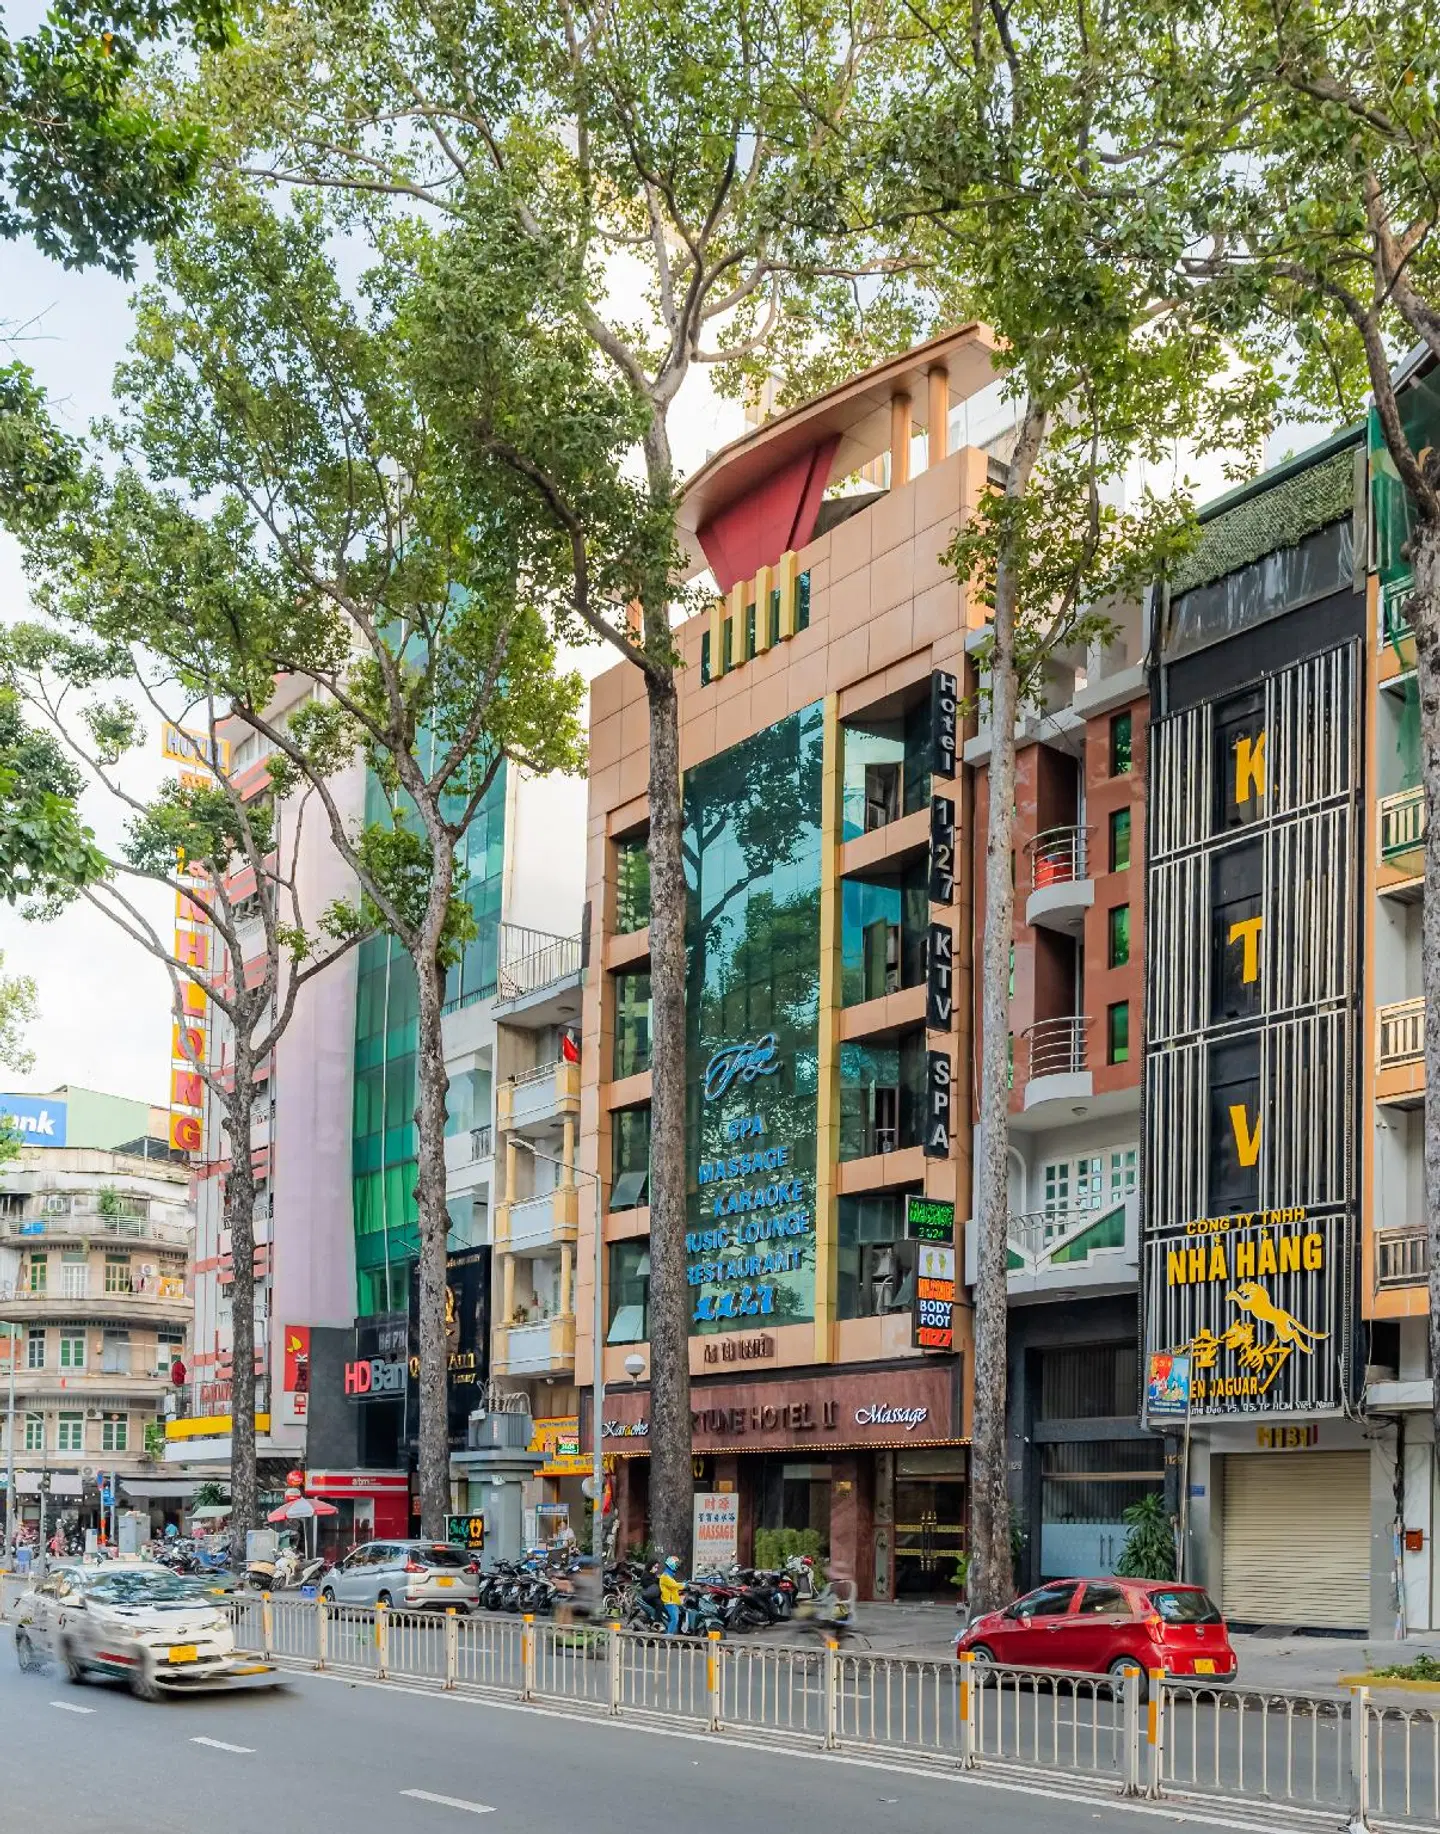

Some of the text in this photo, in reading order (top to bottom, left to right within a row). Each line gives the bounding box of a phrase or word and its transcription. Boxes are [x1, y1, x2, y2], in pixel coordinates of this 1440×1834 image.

[930, 673, 956, 1150] Hotel 1127 KTV SPA
[1229, 730, 1270, 1167] KTV
[728, 1112, 767, 1142] SPA
[698, 1146, 790, 1184] MASSAGE
[713, 1179, 805, 1217] KARAOKE
[737, 1208, 810, 1243] LOUNGE
[1236, 1213, 1254, 1228] TY
[1263, 1207, 1306, 1225] TNHH
[1236, 1227, 1323, 1278] HÀNG
[920, 1300, 952, 1314] BODY
[920, 1313, 951, 1328] FOOT
[344, 1359, 408, 1395] HDBan
[1209, 1376, 1258, 1398] JAGUAR
[601, 1418, 649, 1438] Karaoke
[690, 1408, 746, 1435] RTUNE
[749, 1402, 817, 1431] HOTEL
[855, 1402, 928, 1431] Massage
[1316, 1398, 1335, 1409] Nam
[698, 1525, 735, 1541] MASSAGE
